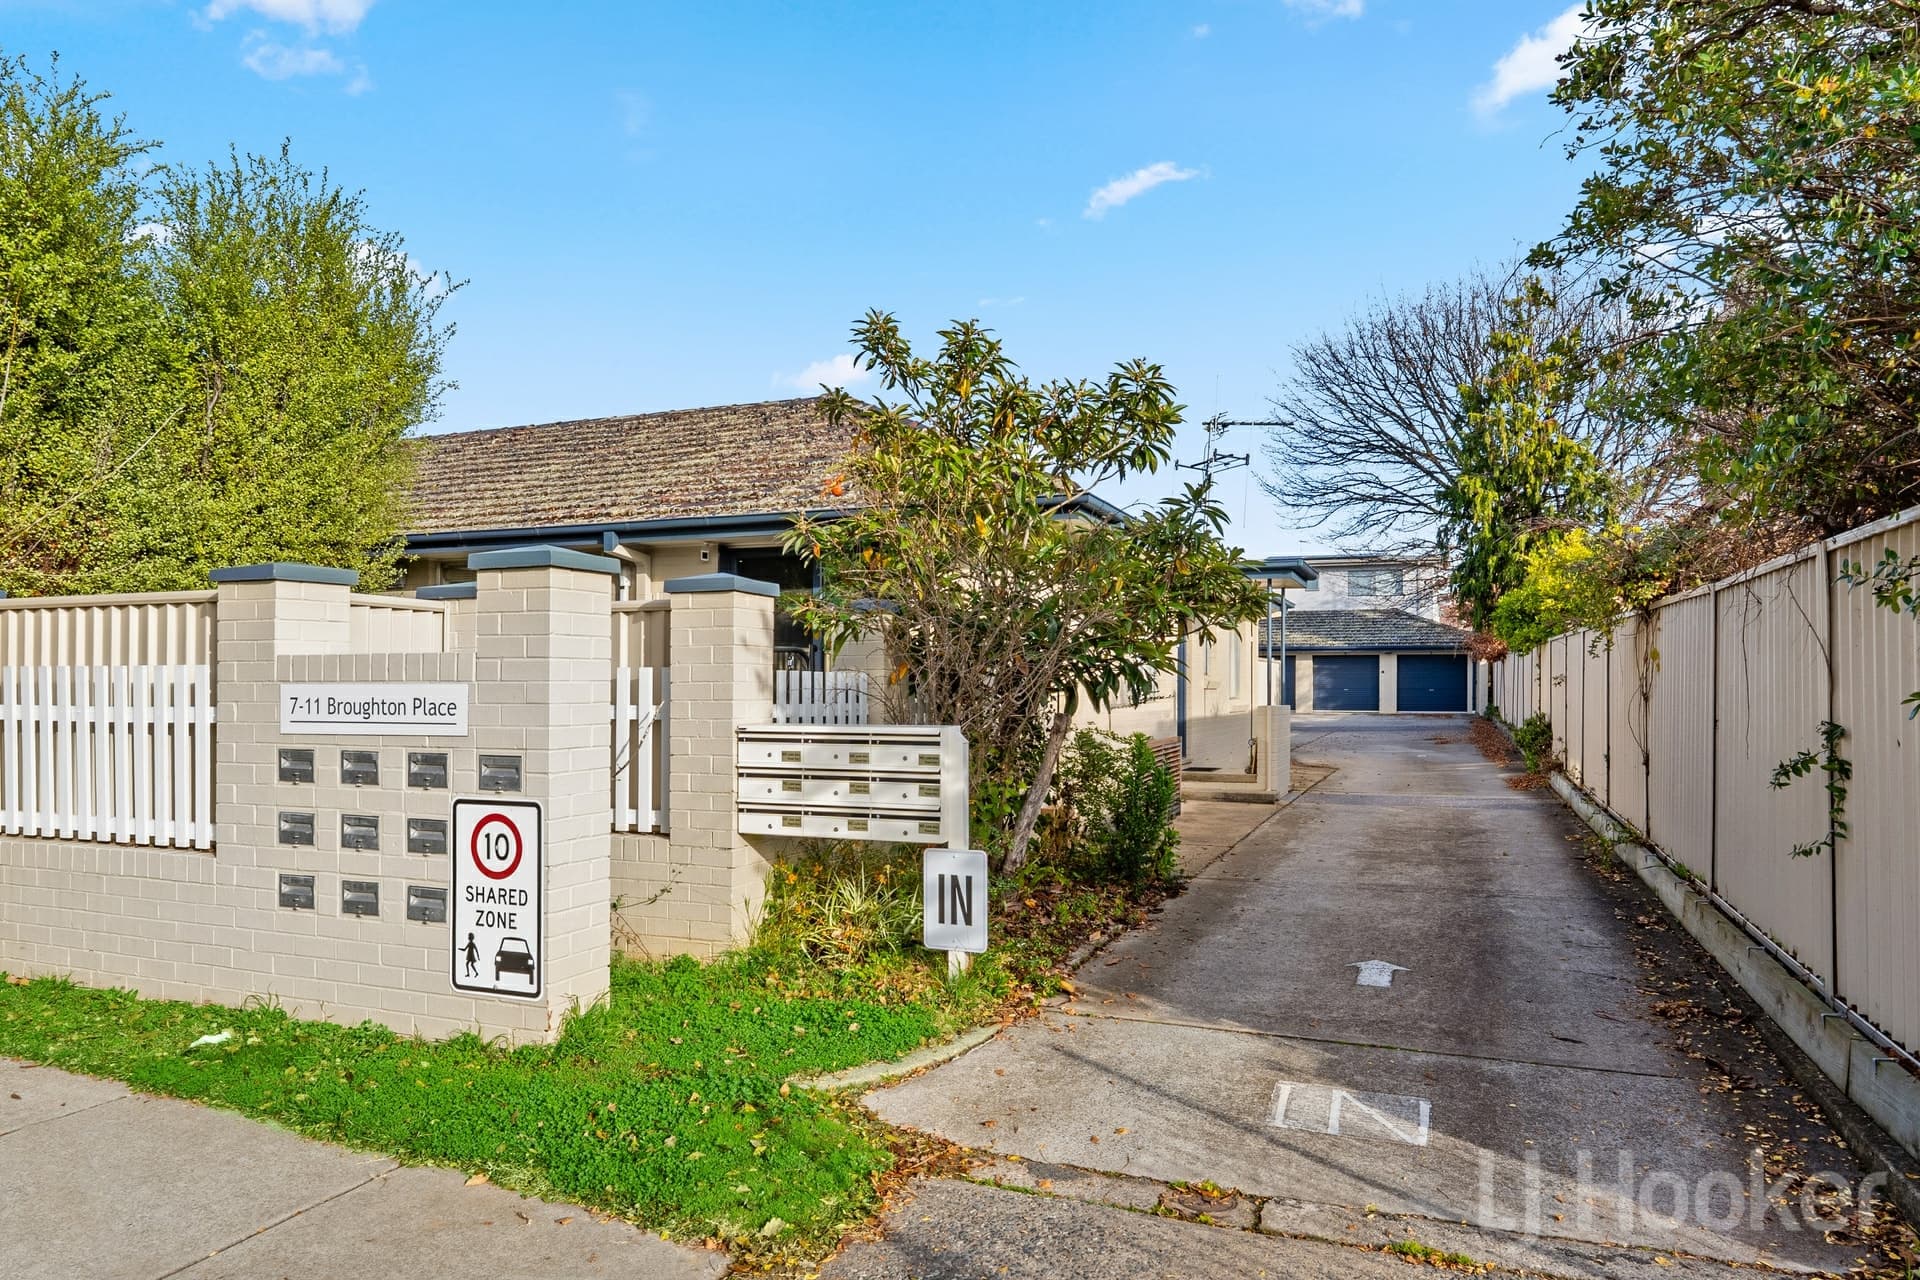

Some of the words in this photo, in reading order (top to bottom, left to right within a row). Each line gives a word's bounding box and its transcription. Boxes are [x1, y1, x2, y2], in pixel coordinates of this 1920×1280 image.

[289, 697, 320, 715] 7-11
[327, 697, 406, 720] Broughton
[413, 697, 457, 717] Place
[484, 832, 510, 861] 10
[465, 885, 528, 907] SHARED
[938, 873, 973, 926] IN
[475, 910, 518, 930] ZONE
[1272, 1081, 1432, 1146] IN
